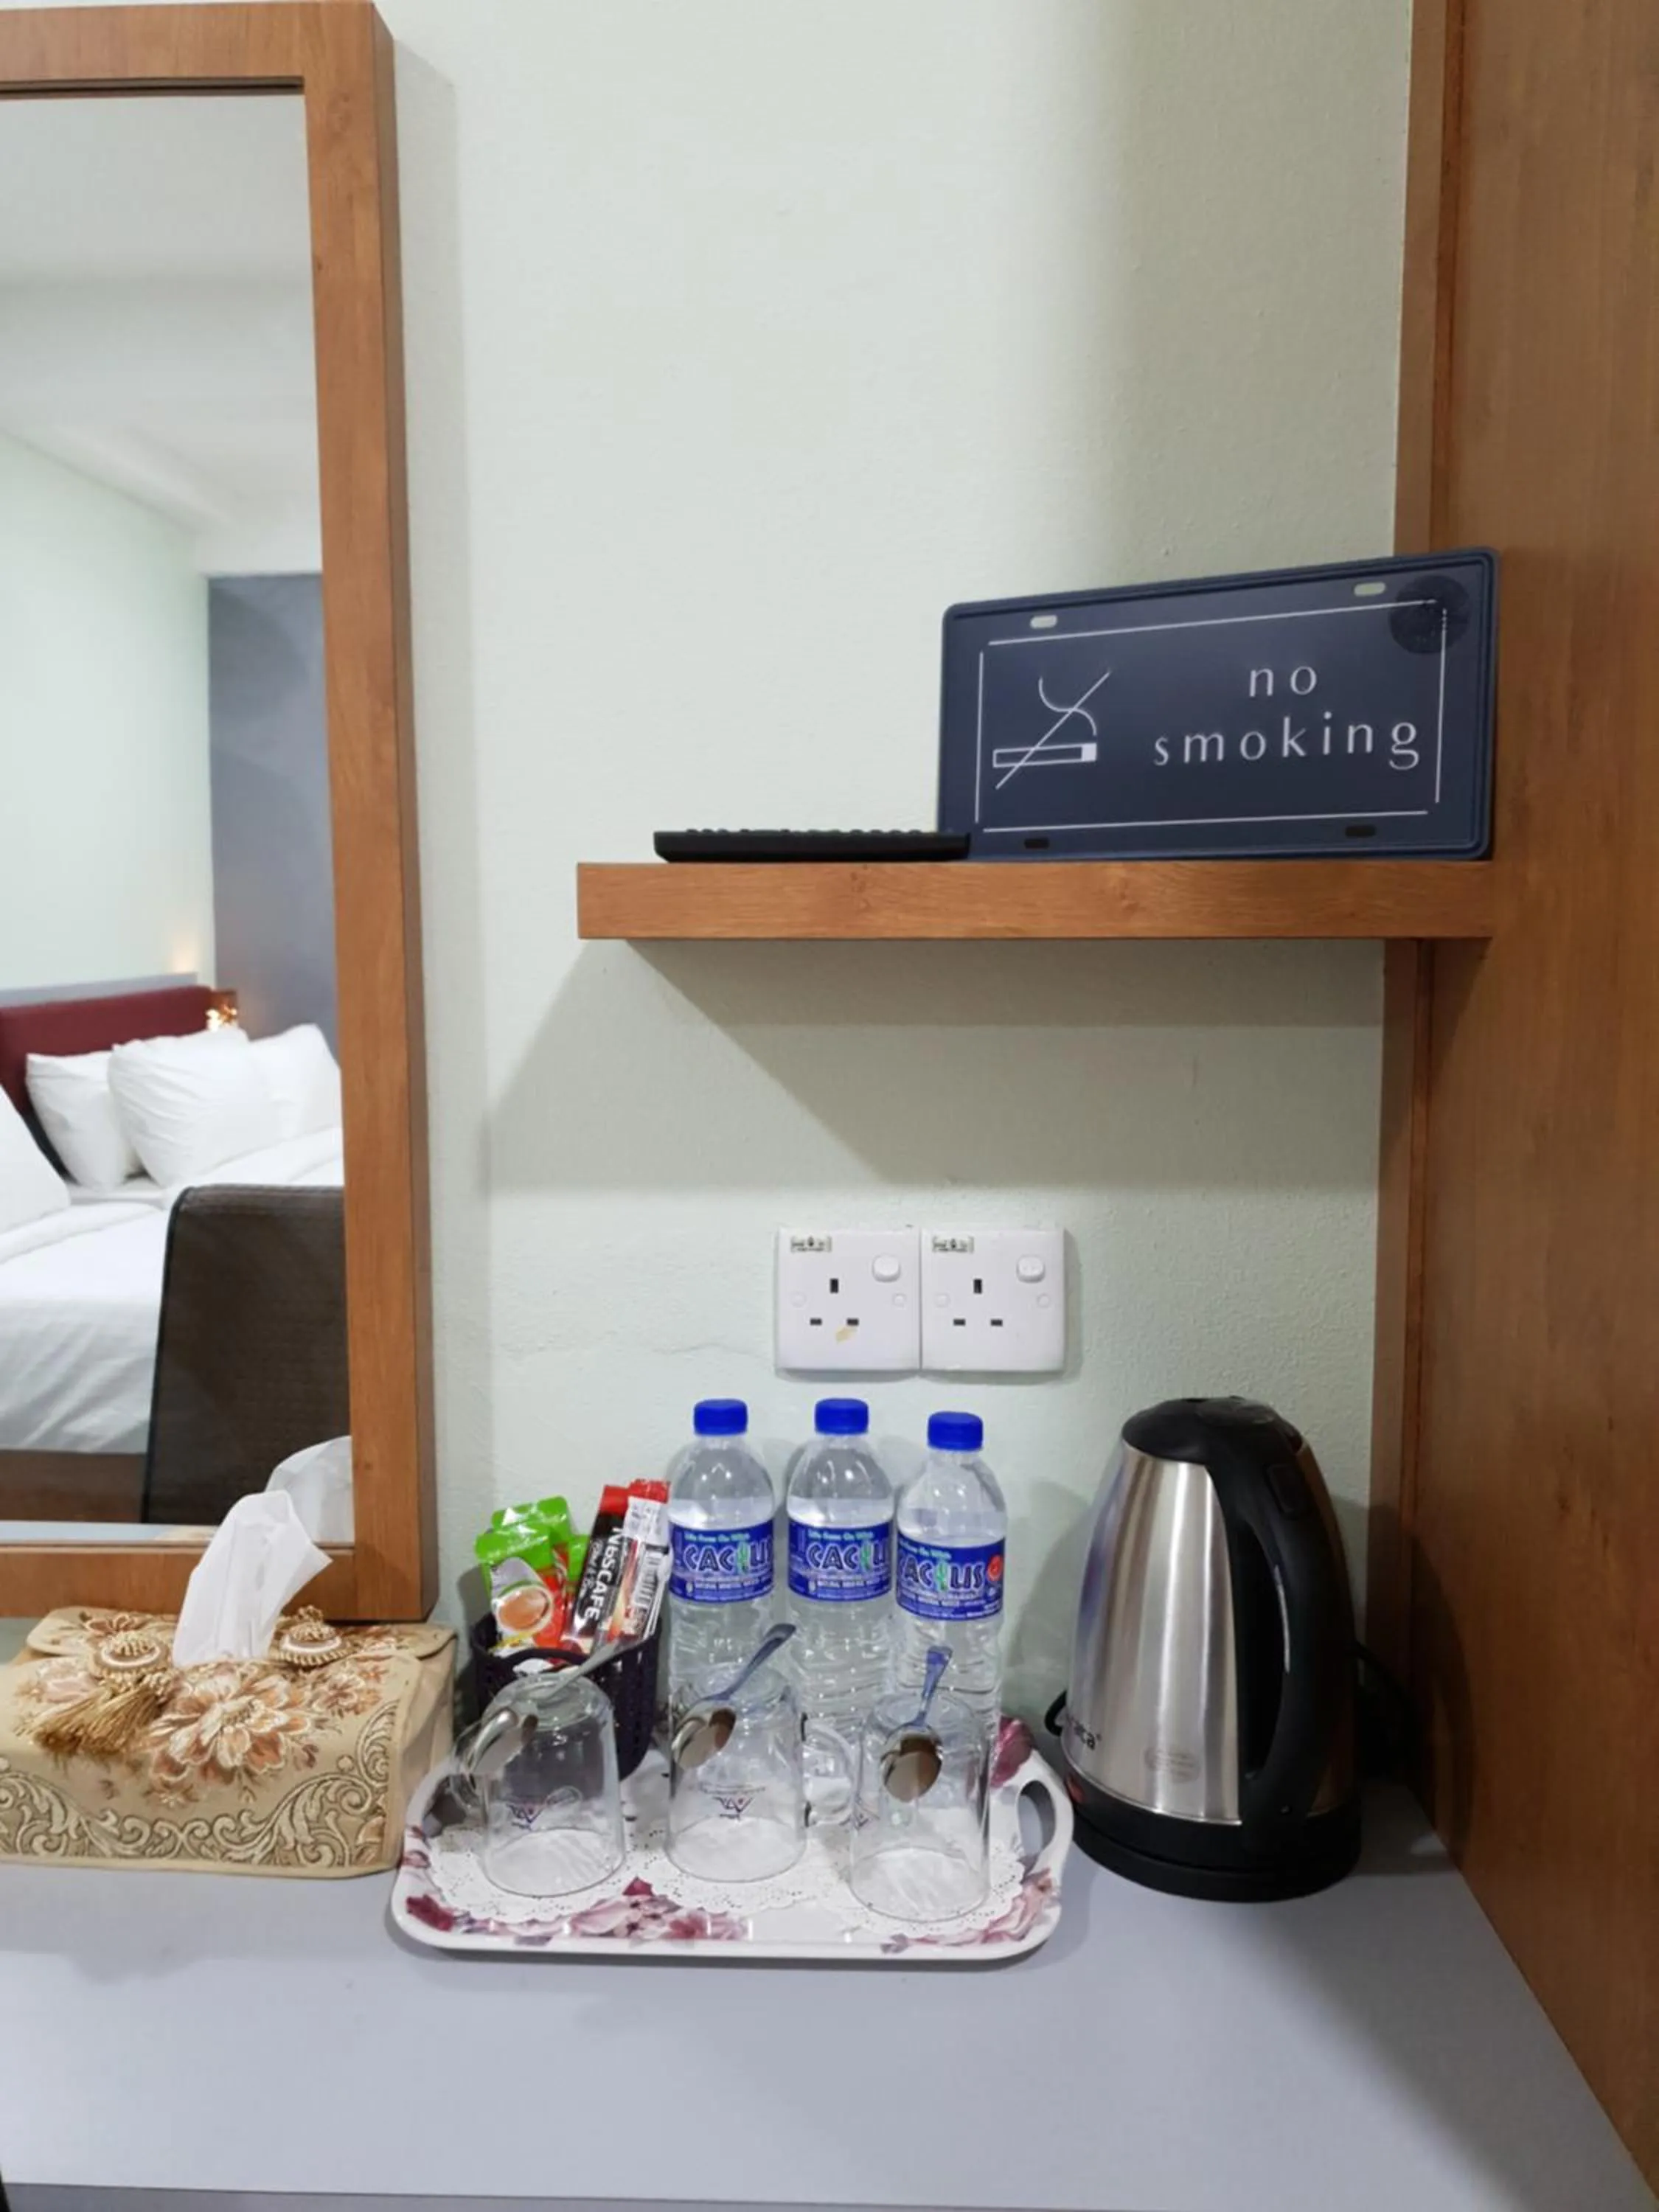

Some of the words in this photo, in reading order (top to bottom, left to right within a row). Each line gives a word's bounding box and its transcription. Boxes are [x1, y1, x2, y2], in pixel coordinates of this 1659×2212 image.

[1248, 665, 1318, 698] no
[1152, 711, 1420, 771] smoking
[683, 1539, 770, 1575] CACTU
[806, 1540, 886, 1574] CACTU
[898, 1553, 986, 1593] ACTUS
